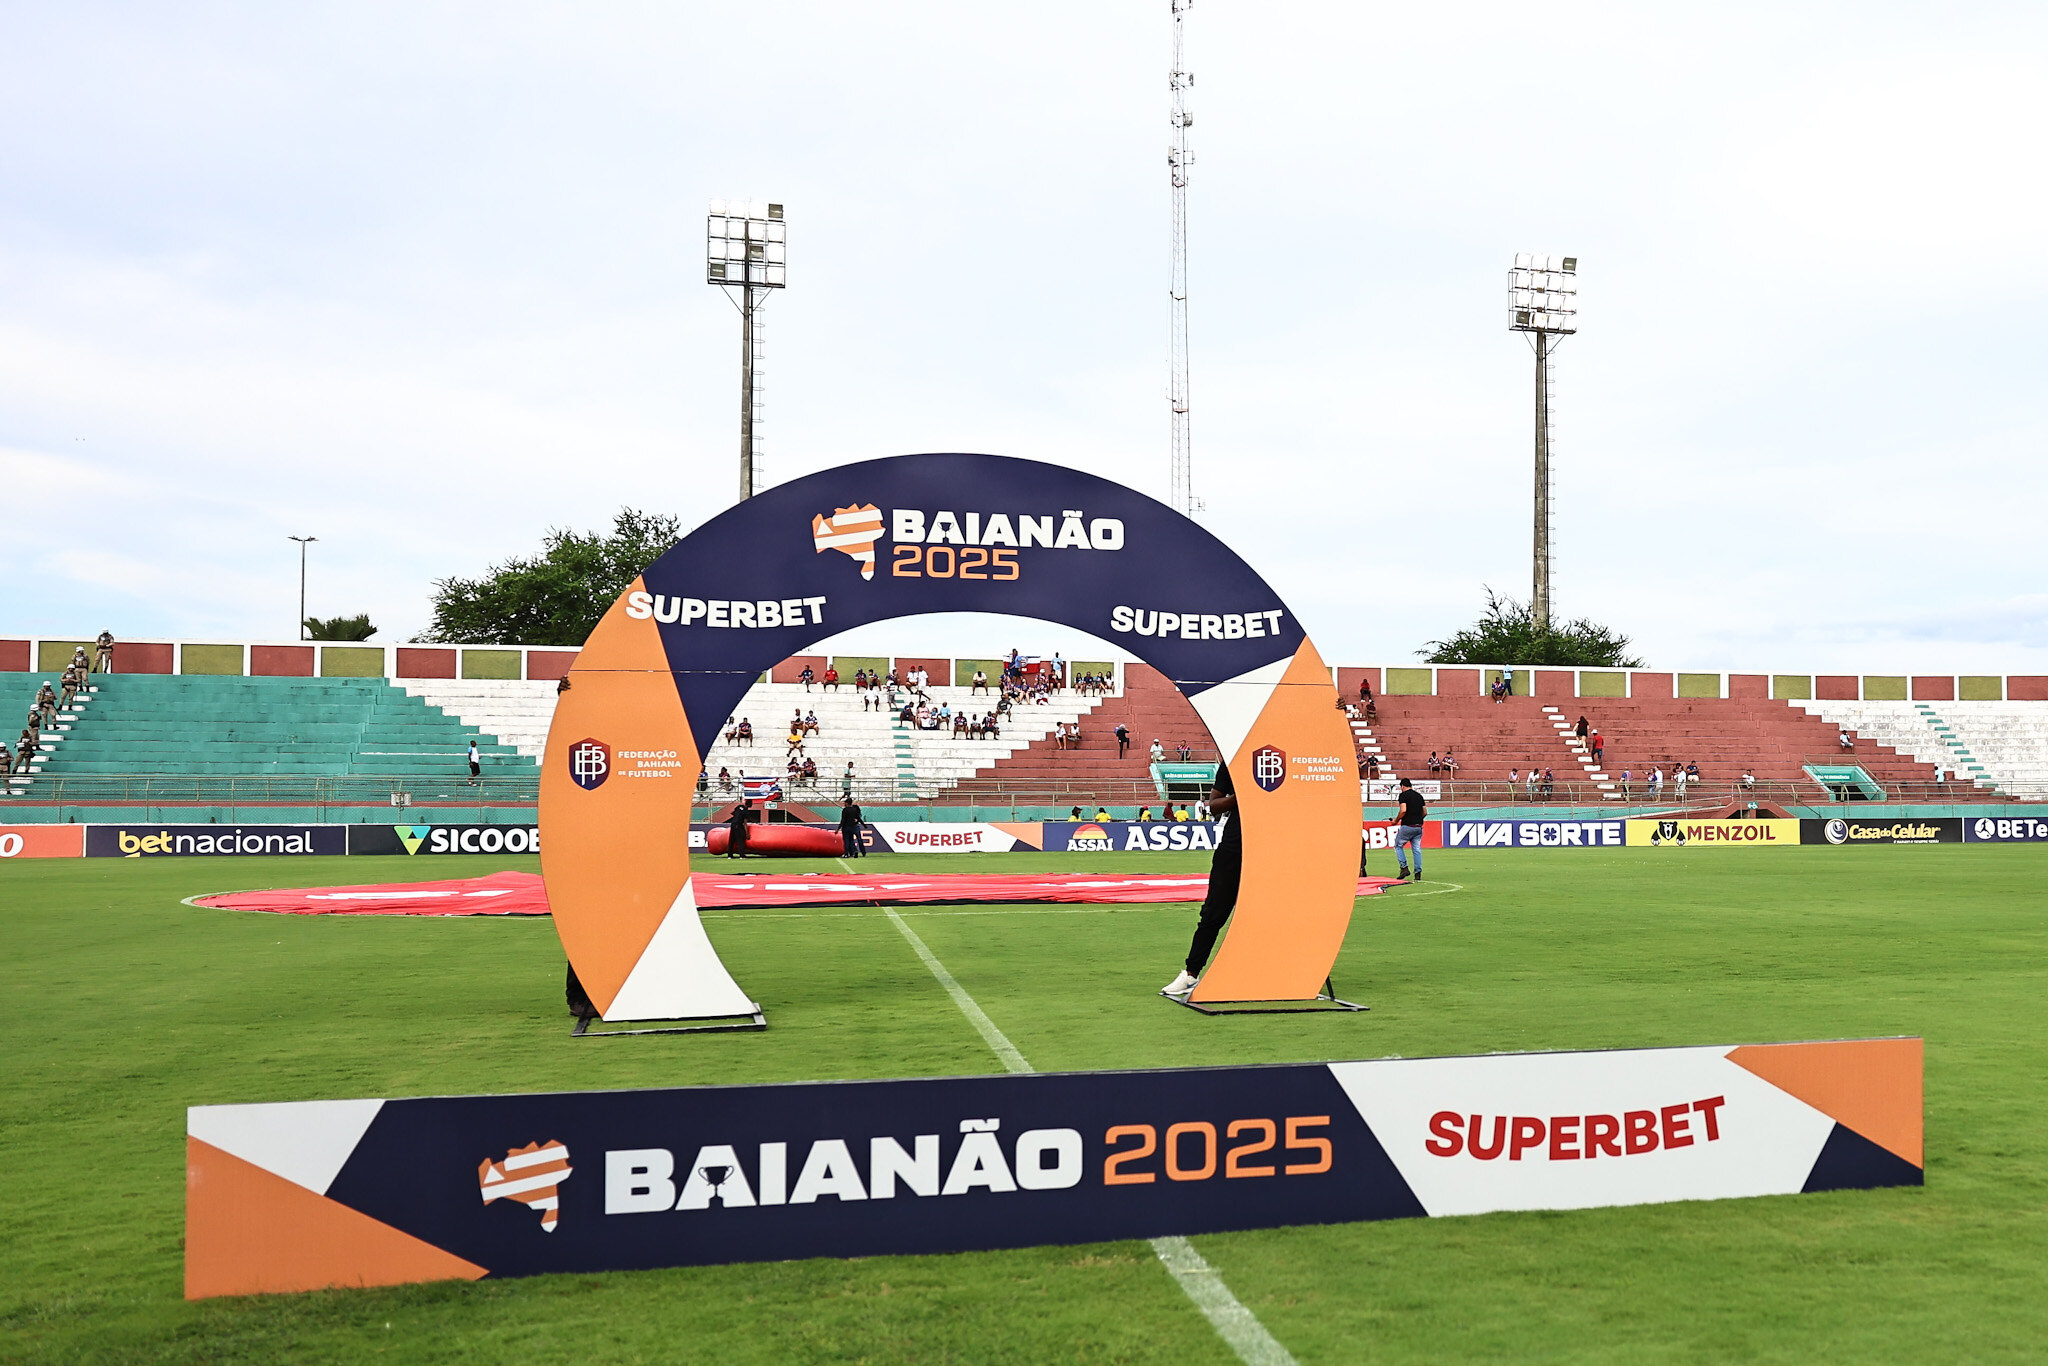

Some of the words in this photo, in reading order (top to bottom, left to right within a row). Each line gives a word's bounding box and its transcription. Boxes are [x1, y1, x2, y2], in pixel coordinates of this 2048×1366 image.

[892, 508, 1124, 551] BAIANÃO
[892, 547, 1020, 581] 2025
[625, 590, 828, 630] SUPERBET
[1110, 604, 1284, 641] SUPERBET
[618, 750, 677, 759] FEDERAÇÃO
[1292, 756, 1340, 765] FEDERAÇÃO
[637, 760, 682, 768] BAHIANA
[1307, 765, 1344, 773] BAHIANA
[628, 770, 672, 778] FUTEBOL
[1300, 774, 1336, 782] FUTEBOL
[894, 830, 983, 846] SUPERBET
[1449, 822, 1513, 846] VIVA
[1519, 822, 1621, 846] SORTE
[1687, 825, 1776, 842] MENZOIL
[1849, 825, 1881, 838] Casa
[1891, 823, 1937, 838] Celular
[119, 829, 314, 858] betnacional
[1425, 1095, 1725, 1162] SUPERBET
[605, 1118, 1083, 1214] BAIANÃO
[1104, 1115, 1332, 1186] 2025
